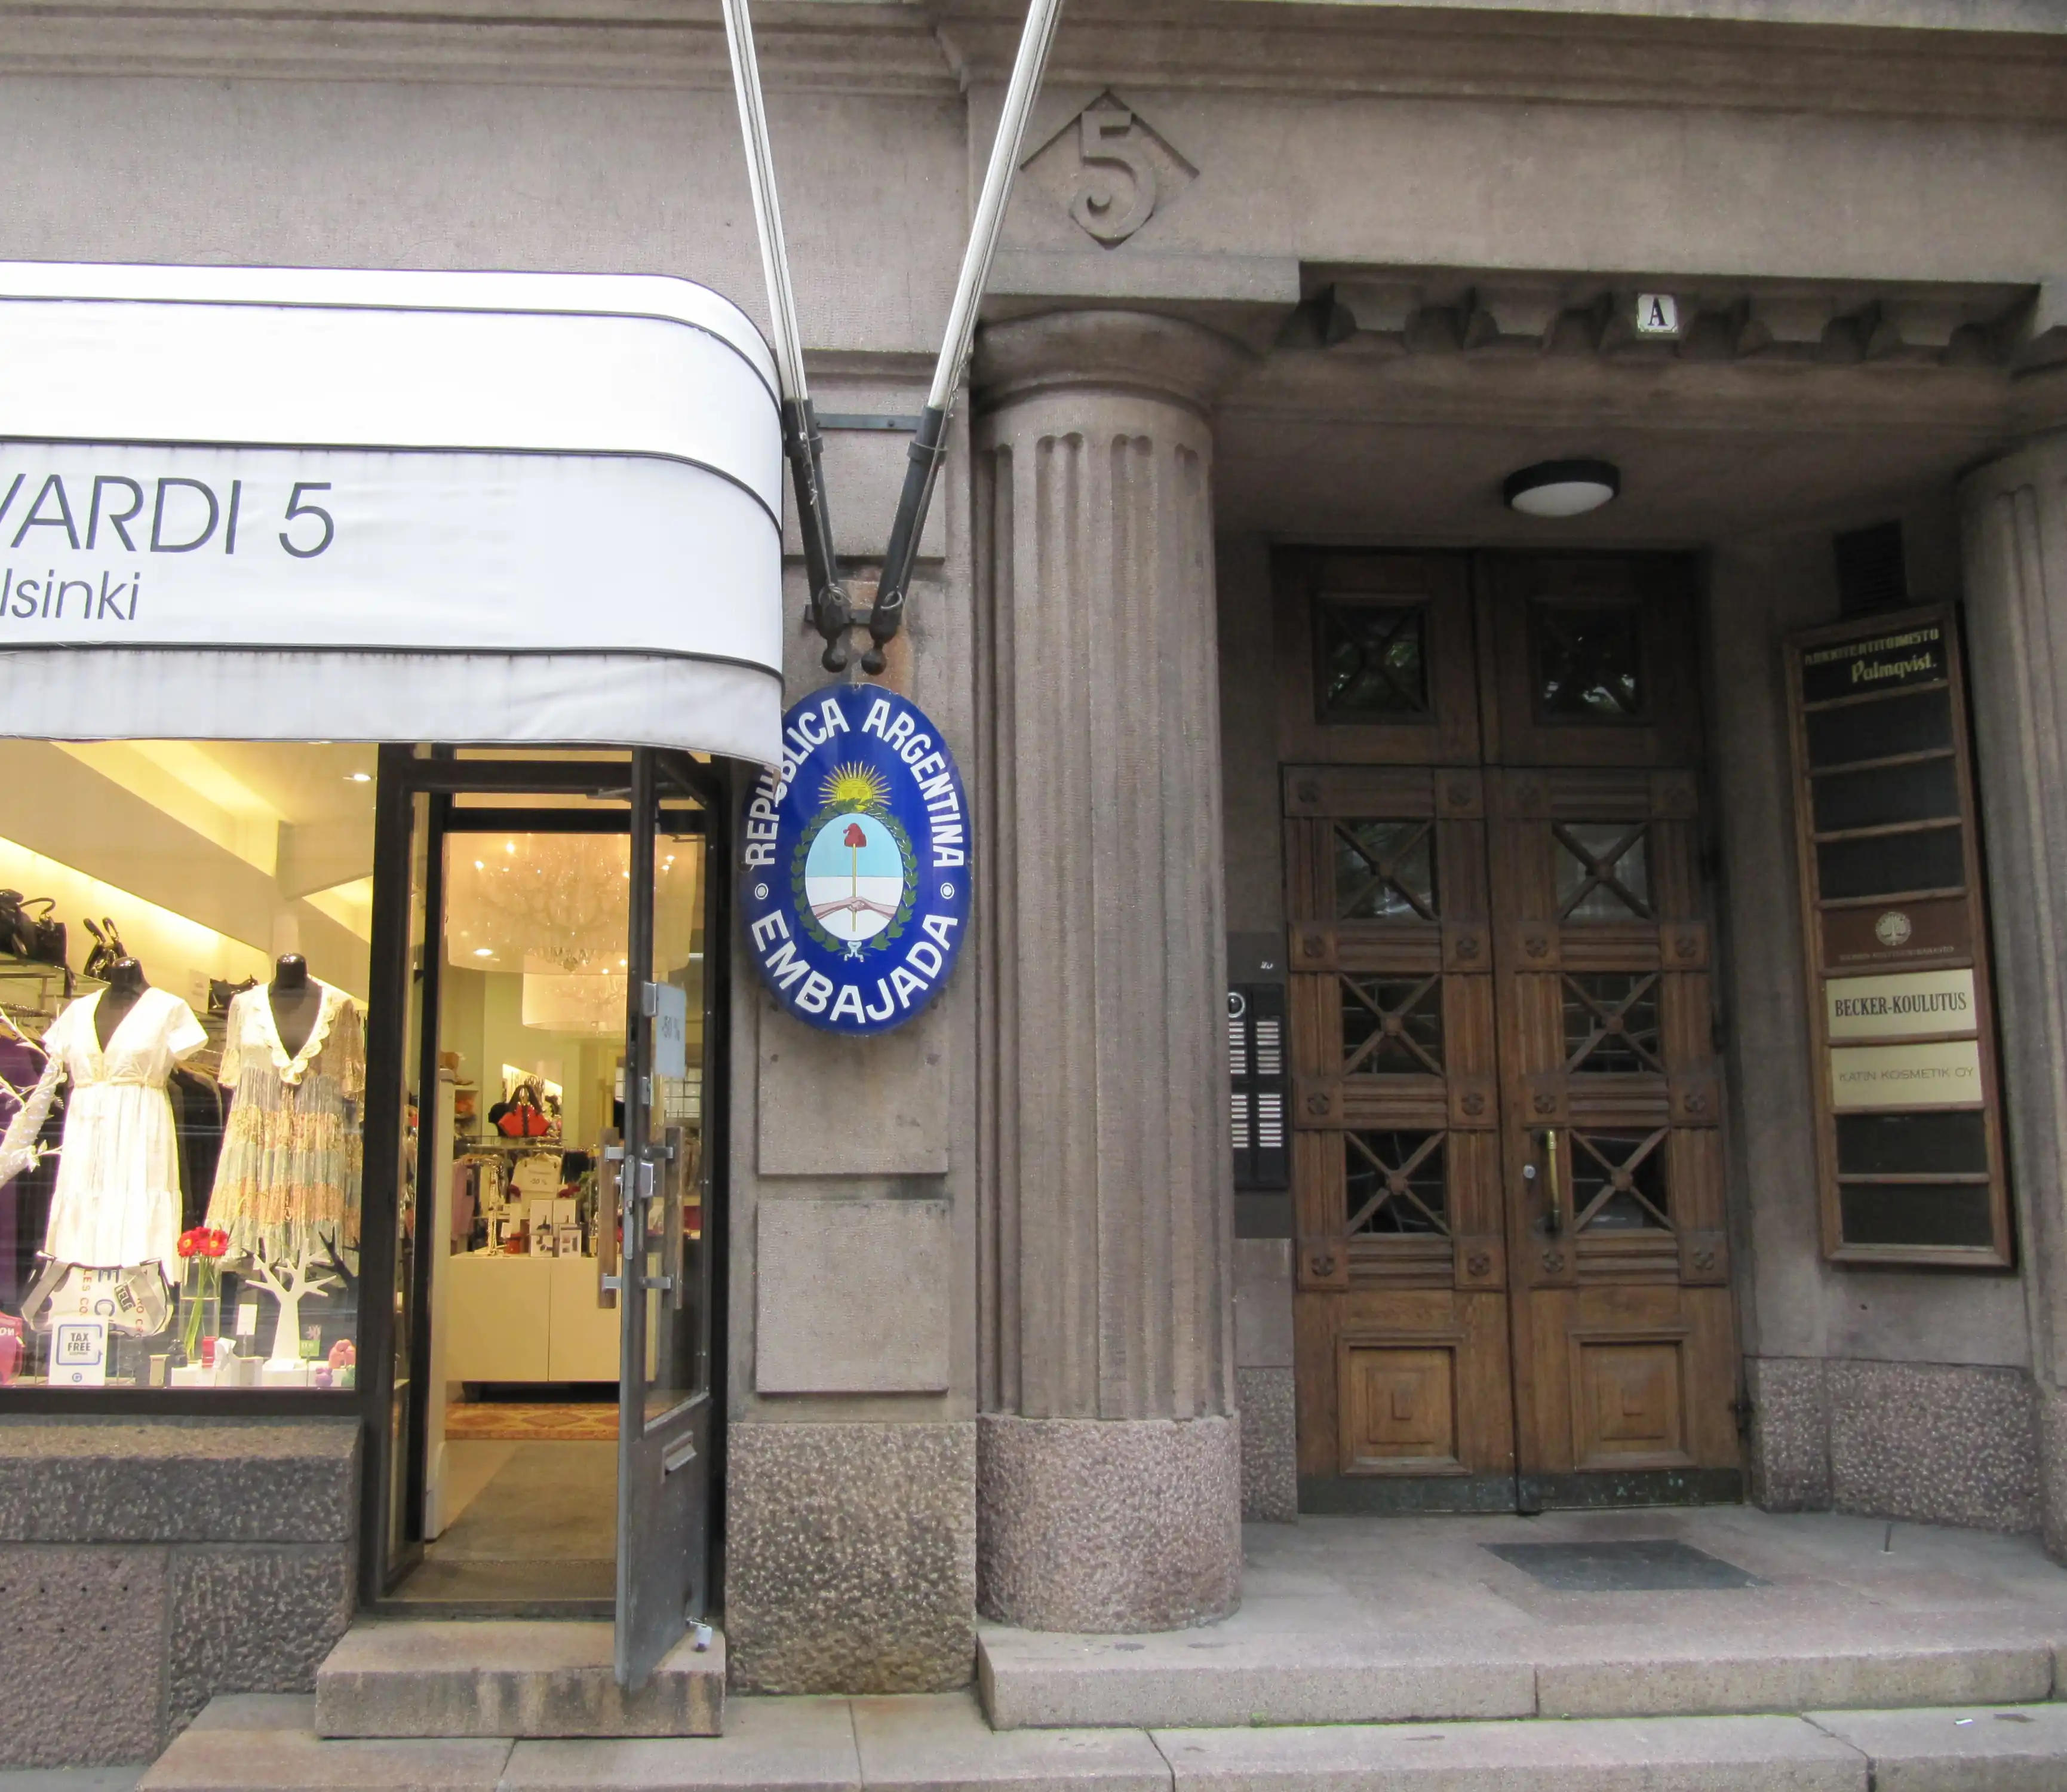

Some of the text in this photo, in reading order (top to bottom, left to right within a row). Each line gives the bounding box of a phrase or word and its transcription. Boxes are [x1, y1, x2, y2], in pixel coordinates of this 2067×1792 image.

[1069, 110, 1156, 241] 5
[1647, 294, 1669, 326] A
[278, 482, 334, 559] 5
[862, 698, 965, 868] ARGENTINA
[750, 909, 959, 1024] EMBAJADA
[1835, 992, 1967, 1017] BECKER-KOULUTUS
[1881, 1067, 1950, 1081] KOSMETIK
[1955, 1067, 1974, 1078] OY
[67, 1342, 91, 1352] FREE
[71, 1333, 88, 1342] TAX
